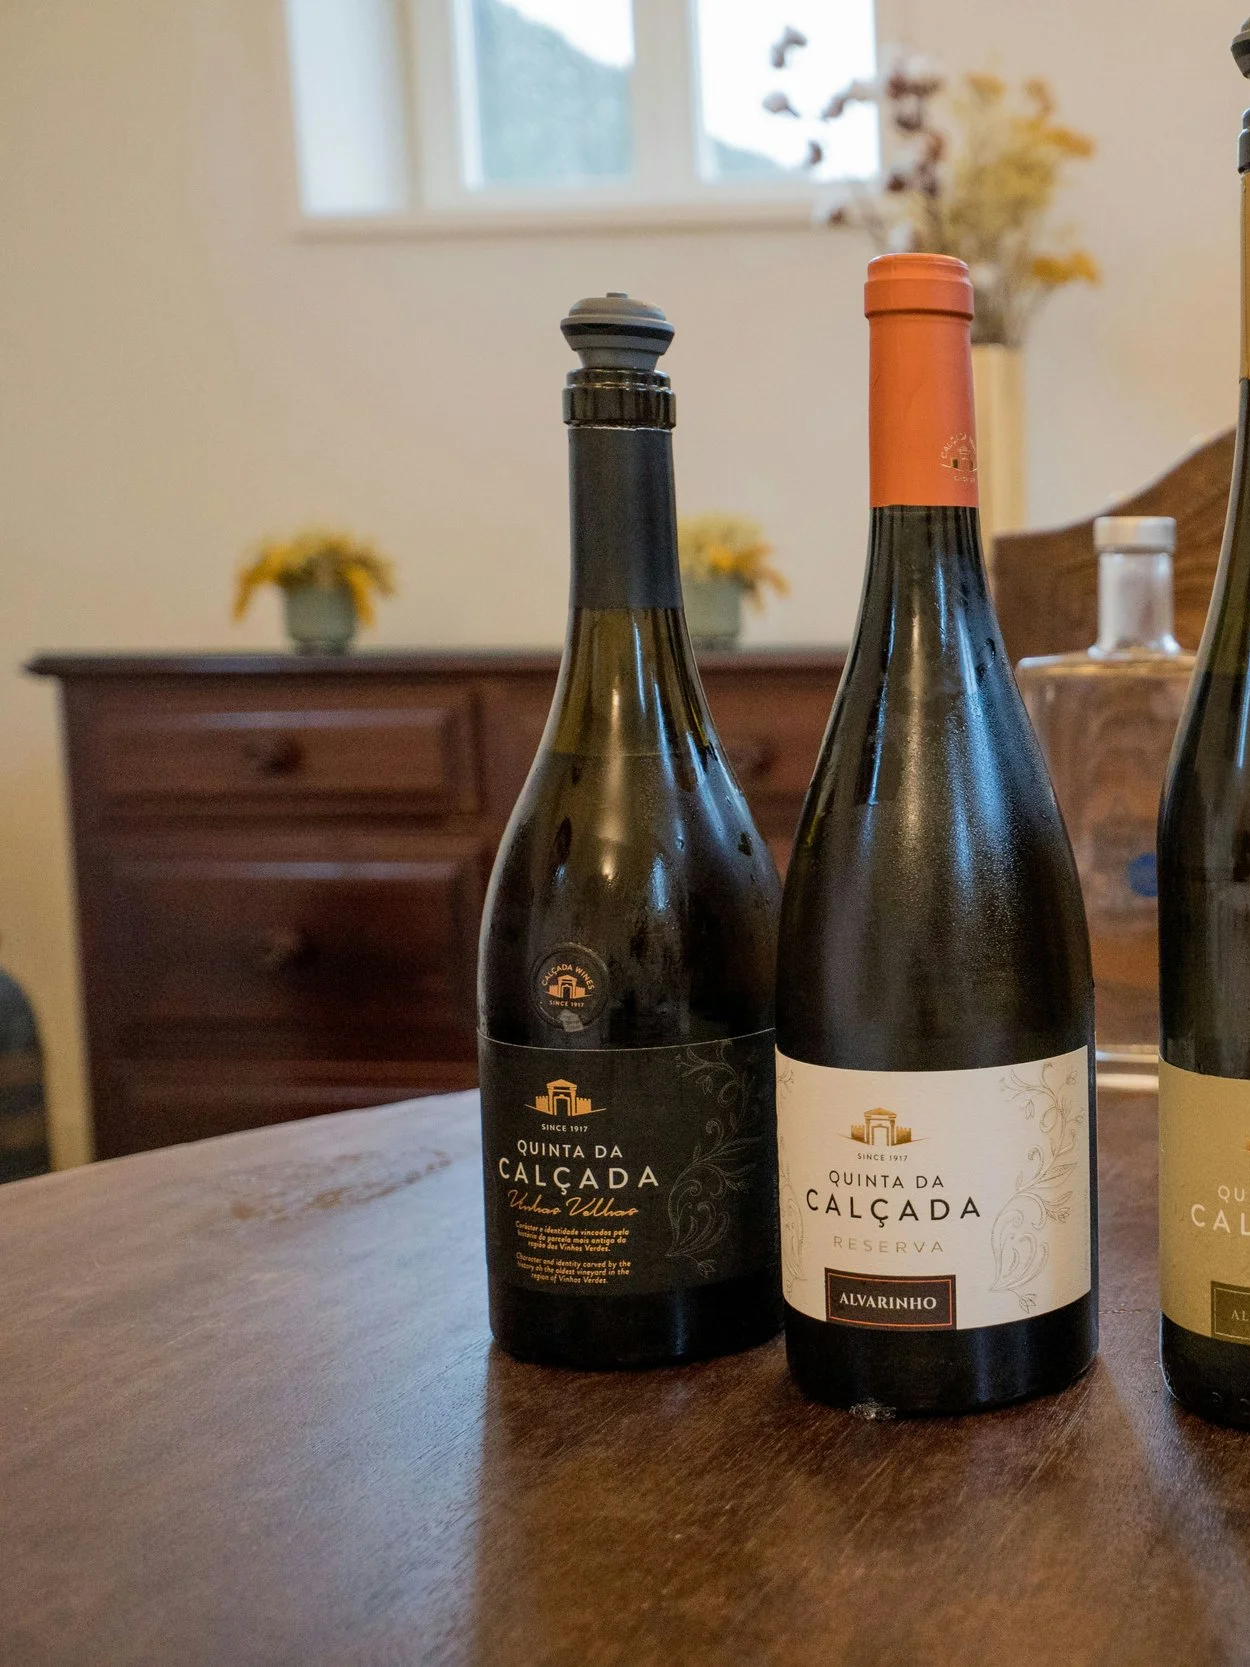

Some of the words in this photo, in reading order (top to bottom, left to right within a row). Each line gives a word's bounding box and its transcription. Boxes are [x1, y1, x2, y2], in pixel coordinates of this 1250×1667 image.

[542, 964, 573, 986] CALÇADA
[575, 966, 595, 990] WINES
[542, 1123, 566, 1132] SINCE
[517, 1140, 584, 1157] QUINTA
[595, 1145, 623, 1158] DA
[857, 1153, 885, 1161] SINCE
[499, 1157, 659, 1195] CALÇADA
[829, 1170, 904, 1188] QUINTA
[916, 1175, 944, 1188] DA
[806, 1189, 980, 1227] CALÇADA
[834, 1236, 943, 1253] RESERVA
[556, 1259, 581, 1269] identity
[608, 1261, 617, 1269] by
[577, 1268, 606, 1277] vineyard
[531, 1273, 549, 1281] region
[840, 1292, 937, 1310] ALVARINHO
